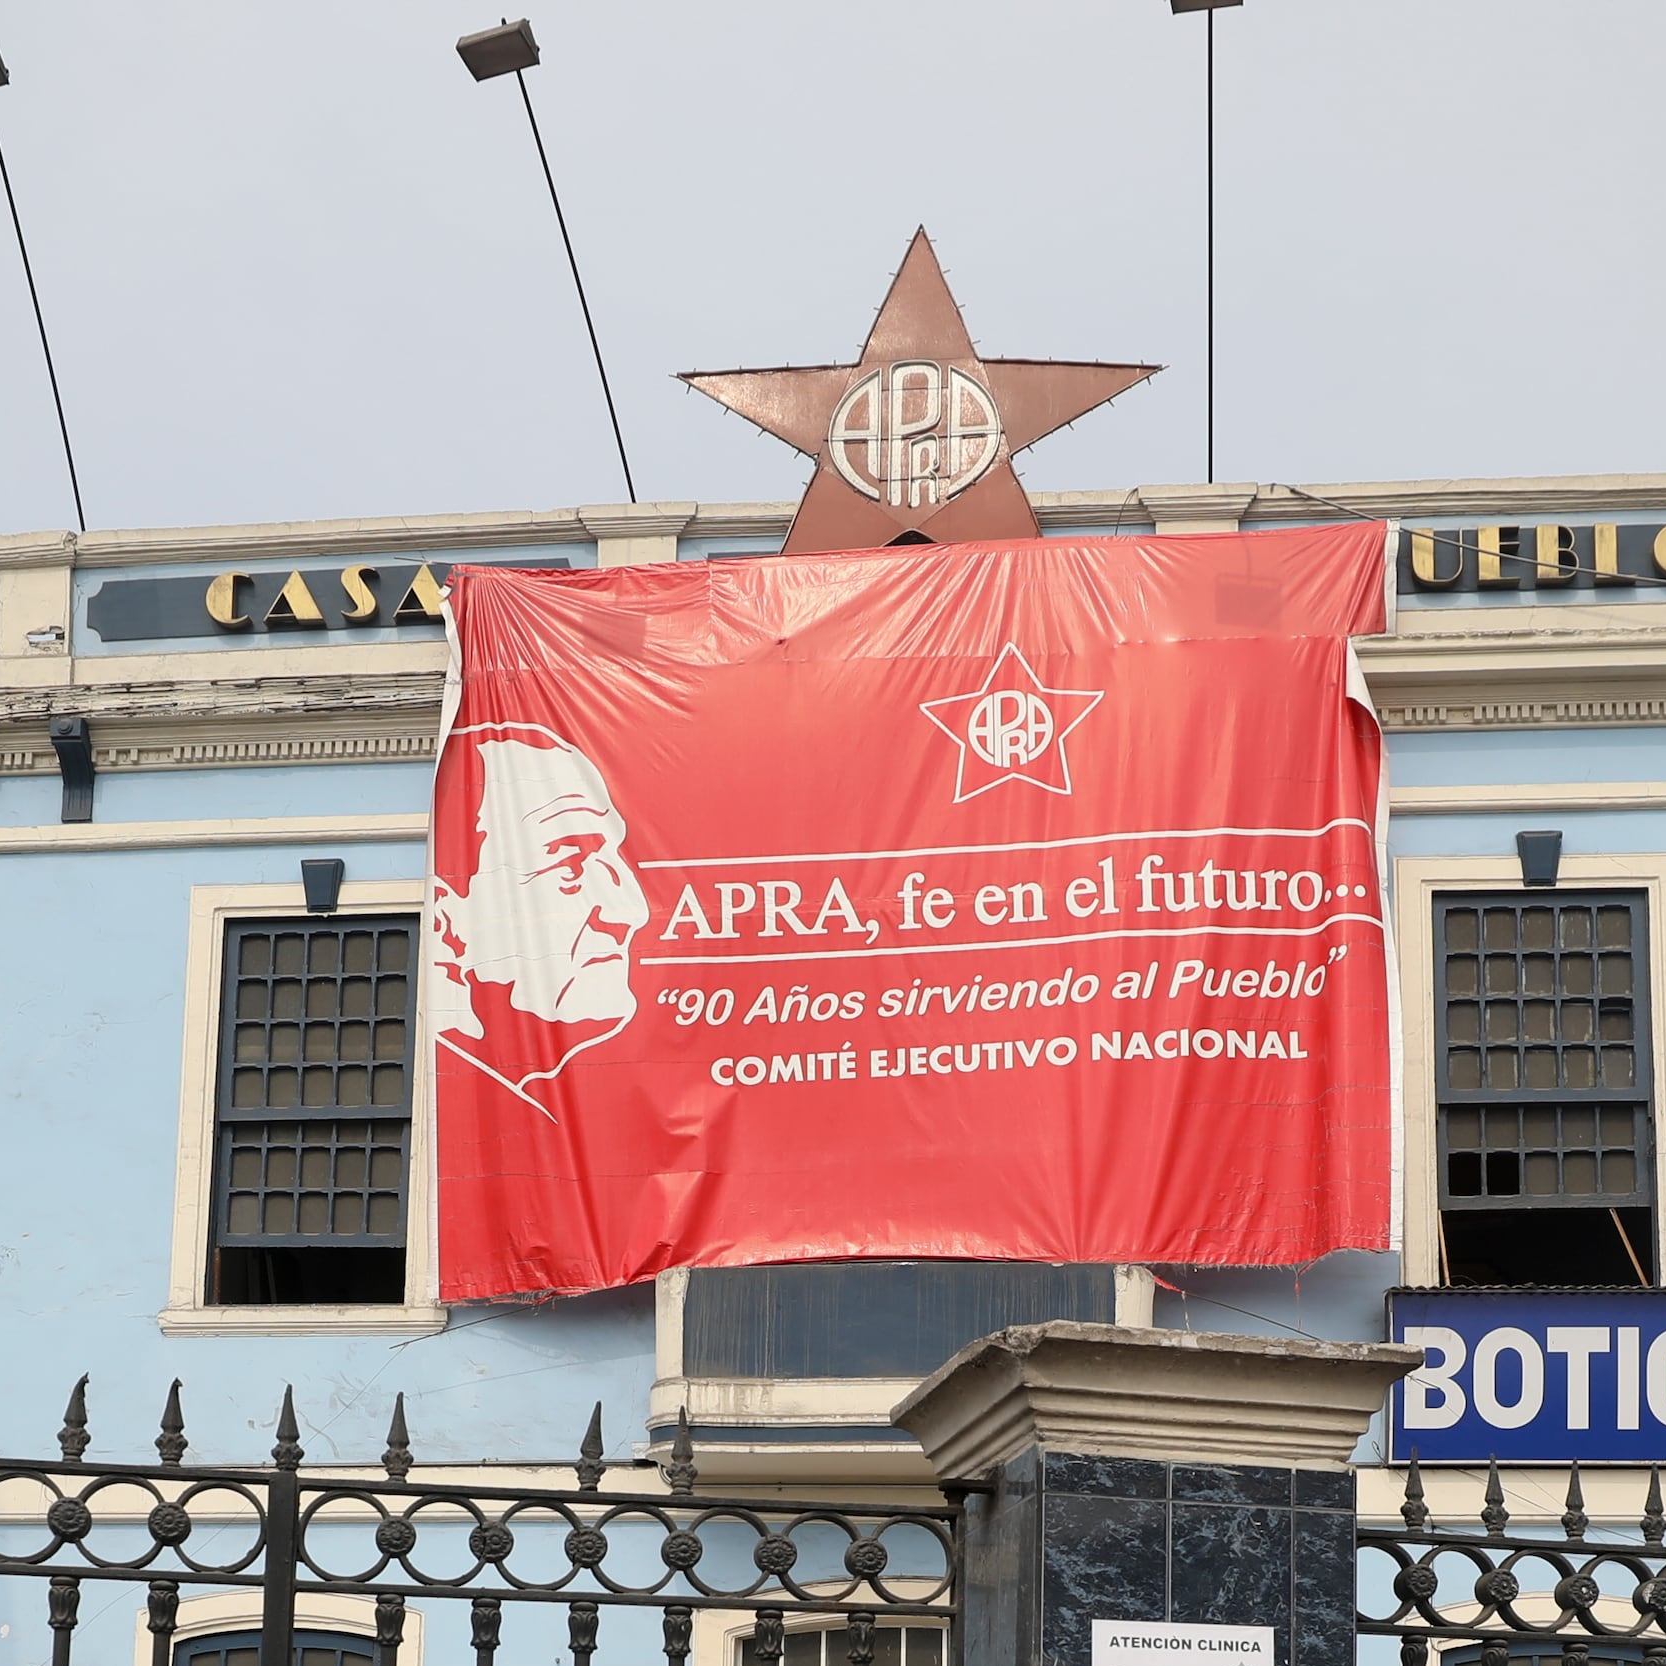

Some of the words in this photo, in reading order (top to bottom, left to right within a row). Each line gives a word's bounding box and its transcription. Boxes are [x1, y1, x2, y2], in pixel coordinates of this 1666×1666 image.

[205, 562, 445, 628] CASA
[659, 876, 883, 946] APRA,
[896, 868, 957, 931] fe
[974, 868, 1049, 926] en
[1064, 858, 1119, 919] el
[1134, 854, 1368, 917] futuro...
[744, 982, 864, 1027] Años
[877, 966, 1095, 1018] sirviendo
[1111, 960, 1159, 1003] al
[710, 1040, 857, 1087] COMITÉ
[869, 1035, 1079, 1080] EJECUTIVO
[1090, 1028, 1309, 1064] NACIONAL
[1197, 1639, 1262, 1653] CLINICA
